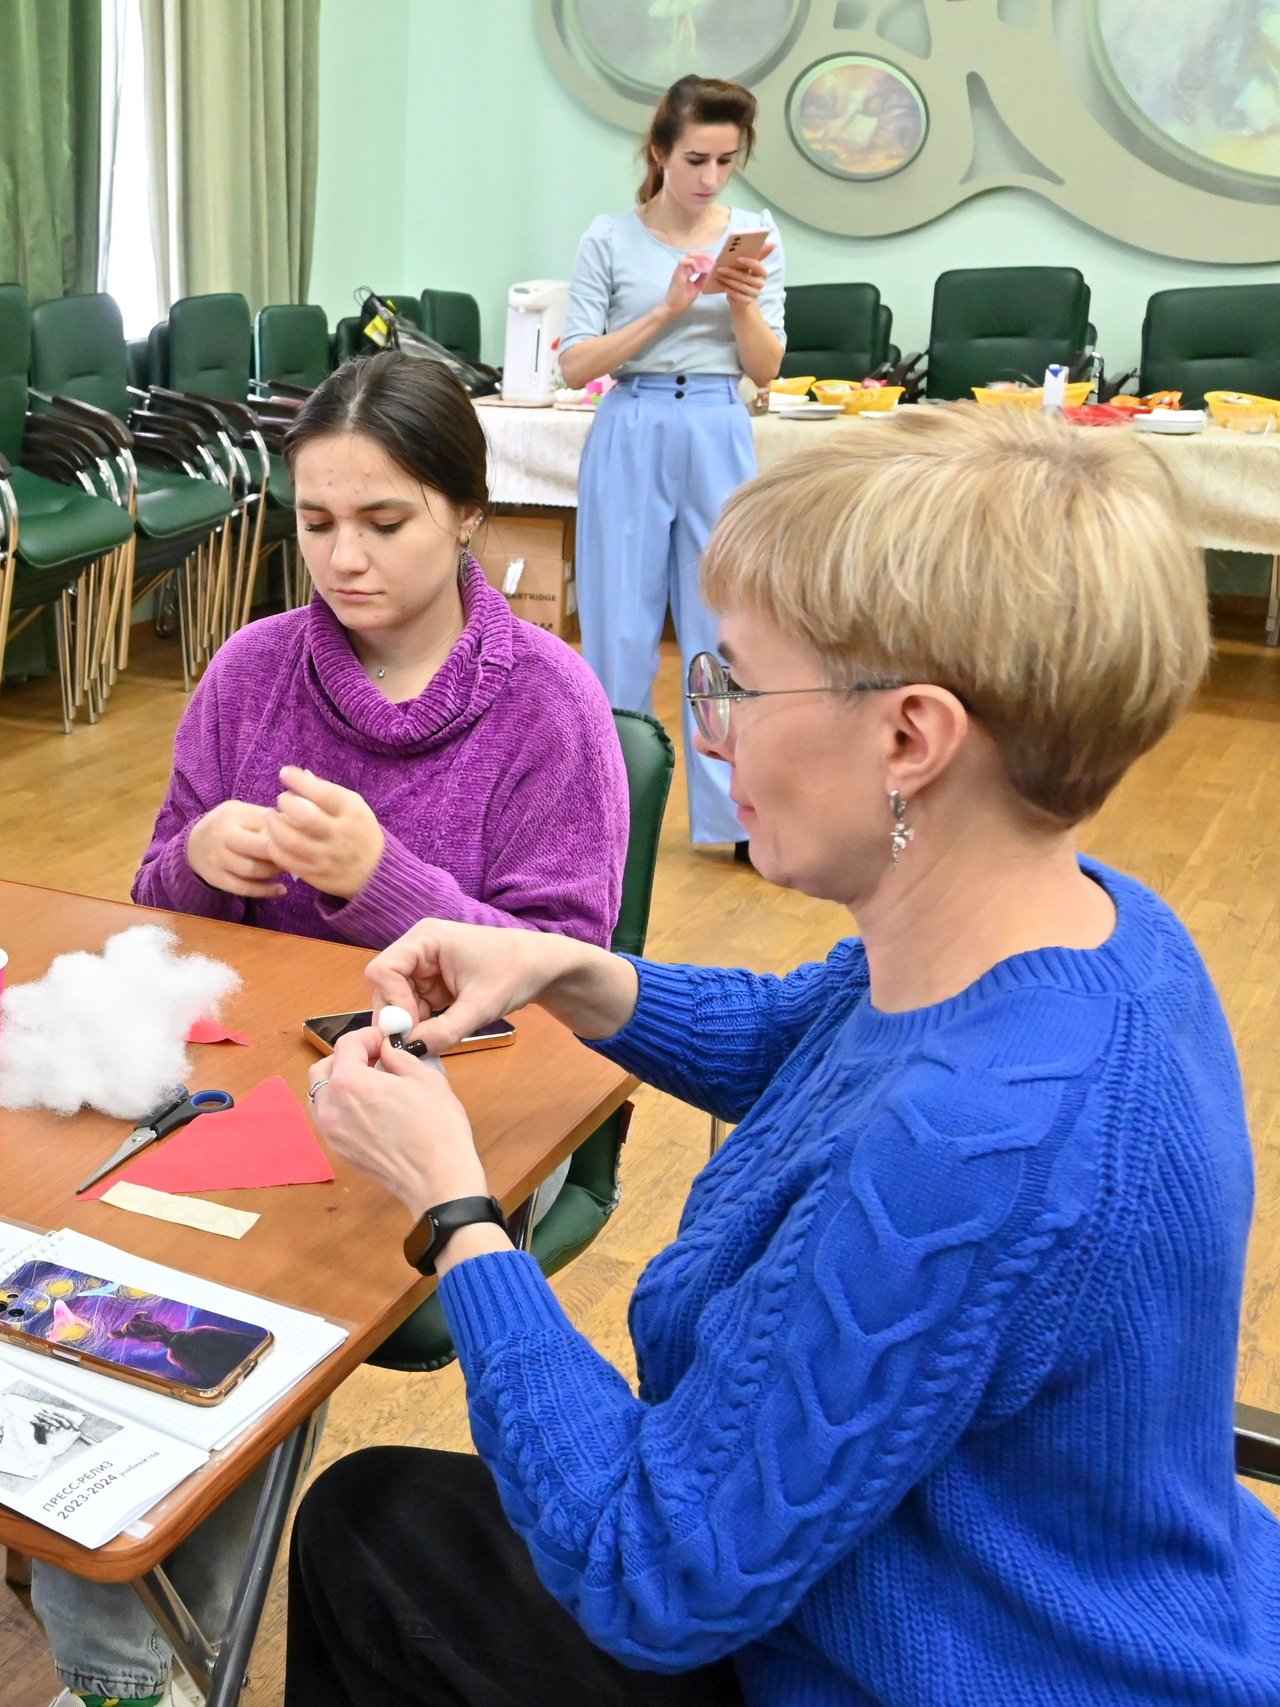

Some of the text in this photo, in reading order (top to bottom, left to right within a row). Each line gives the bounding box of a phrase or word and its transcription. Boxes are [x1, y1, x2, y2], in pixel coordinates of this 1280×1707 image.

[42, 1460, 114, 1512] ПРЕСС-РЕЛИЗ
[57, 1451, 160, 1520] 2023-2024 учебный год
